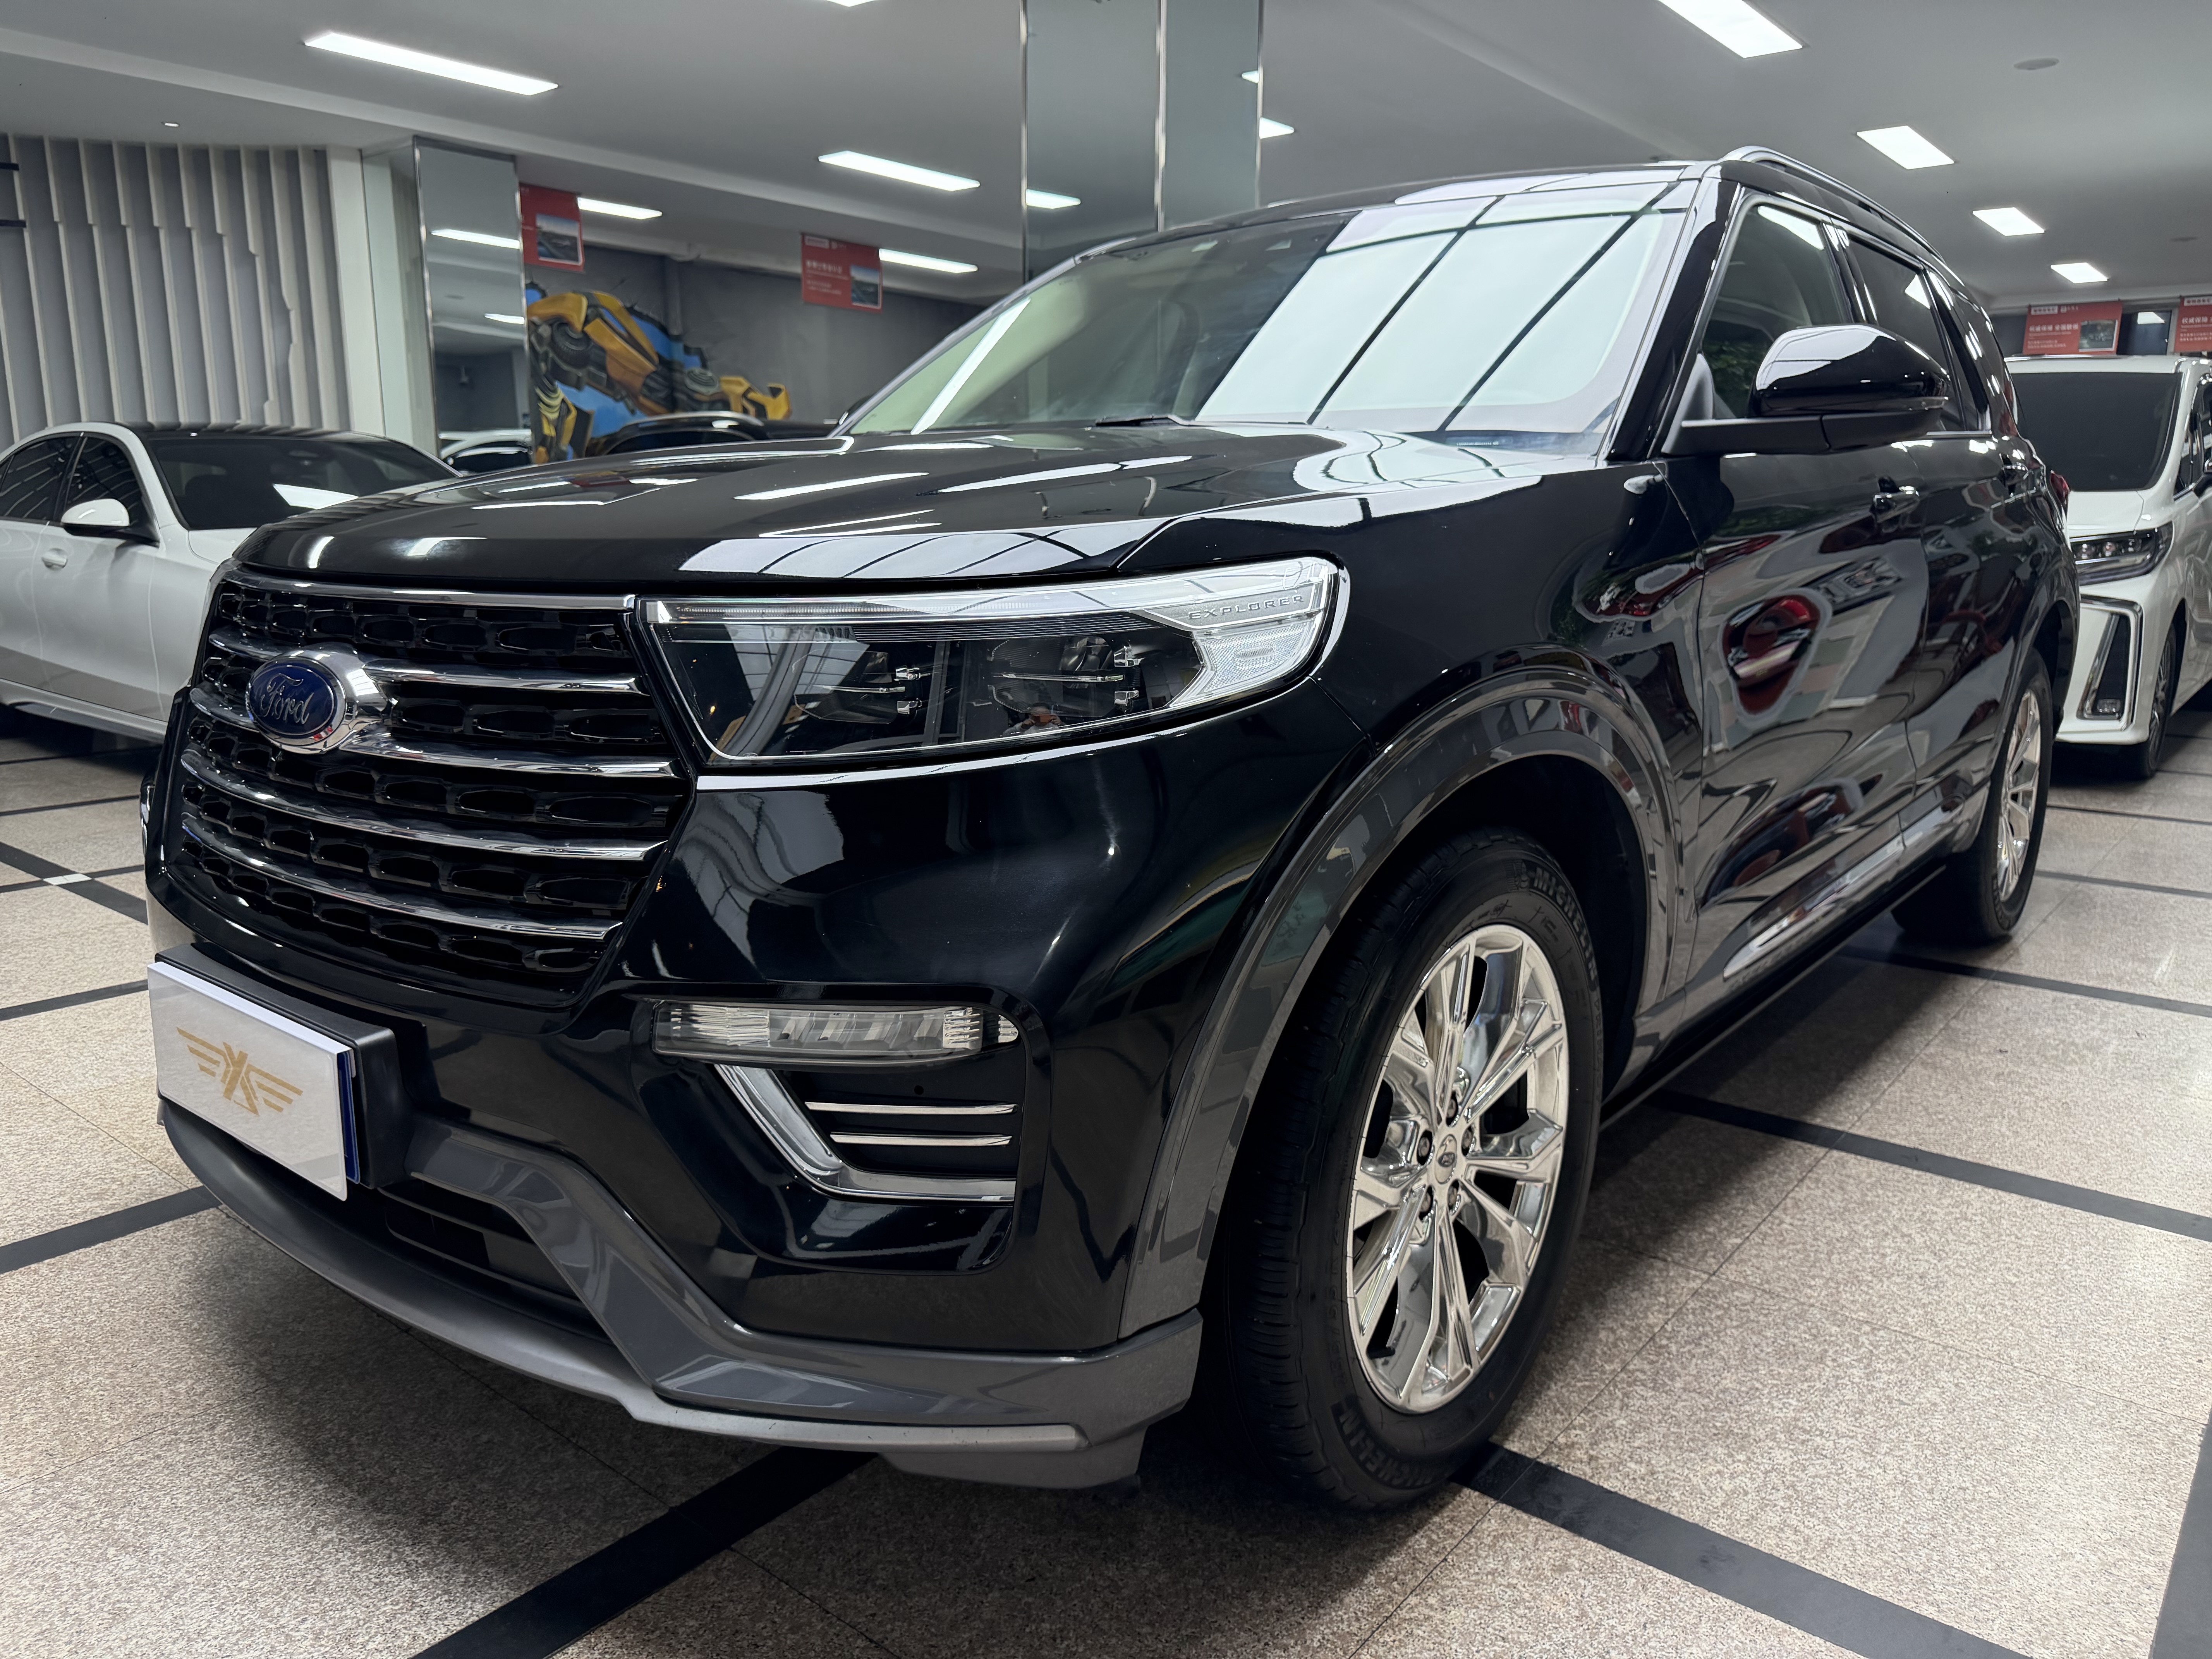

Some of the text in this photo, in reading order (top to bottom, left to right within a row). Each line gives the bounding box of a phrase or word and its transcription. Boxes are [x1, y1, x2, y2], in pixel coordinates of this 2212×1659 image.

[1188, 595, 1304, 620] EXPLORER
[261, 673, 314, 725] Ford
[1533, 867, 1597, 982] MICHELIN
